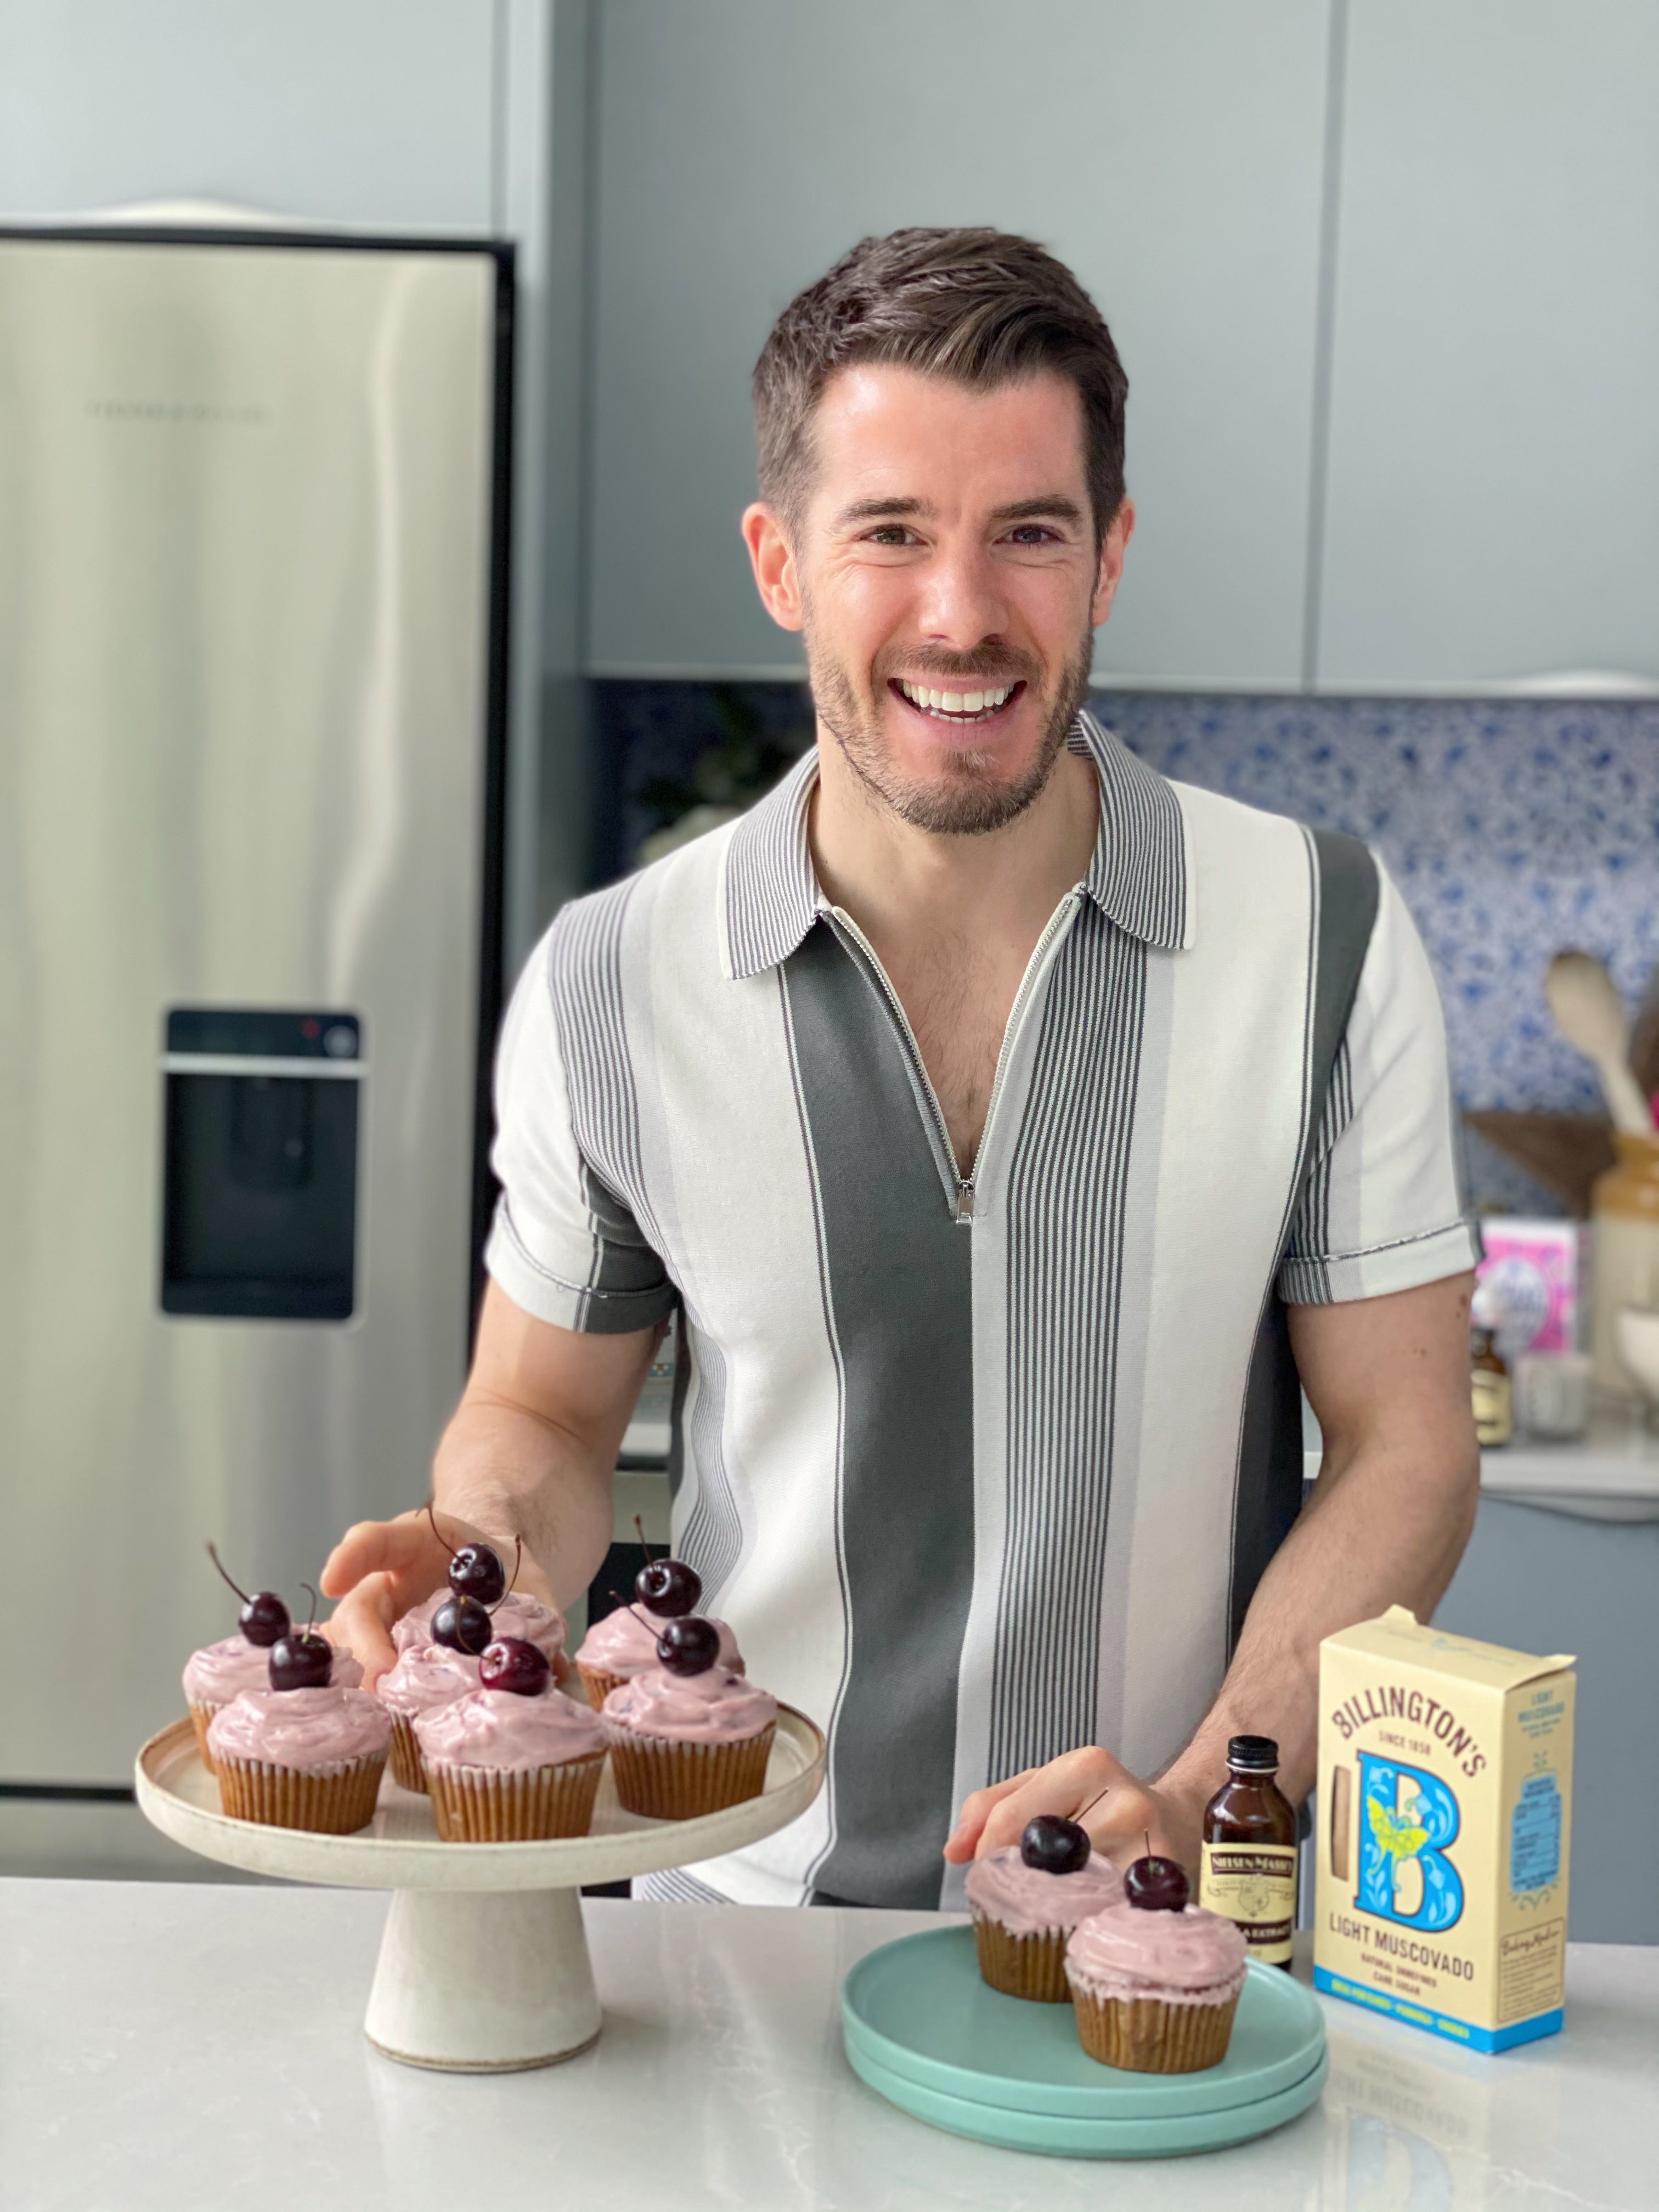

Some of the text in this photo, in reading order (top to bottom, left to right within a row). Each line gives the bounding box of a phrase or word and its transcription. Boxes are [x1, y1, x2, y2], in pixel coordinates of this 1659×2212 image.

[1331, 1686, 1486, 1778] BILLINGTON'S
[1379, 1730, 1405, 1748] SINCE
[1354, 1748, 1464, 1933] B
[1330, 1912, 1370, 1944] LIGHT
[1375, 1929, 1474, 1980] MUSCOVADO
